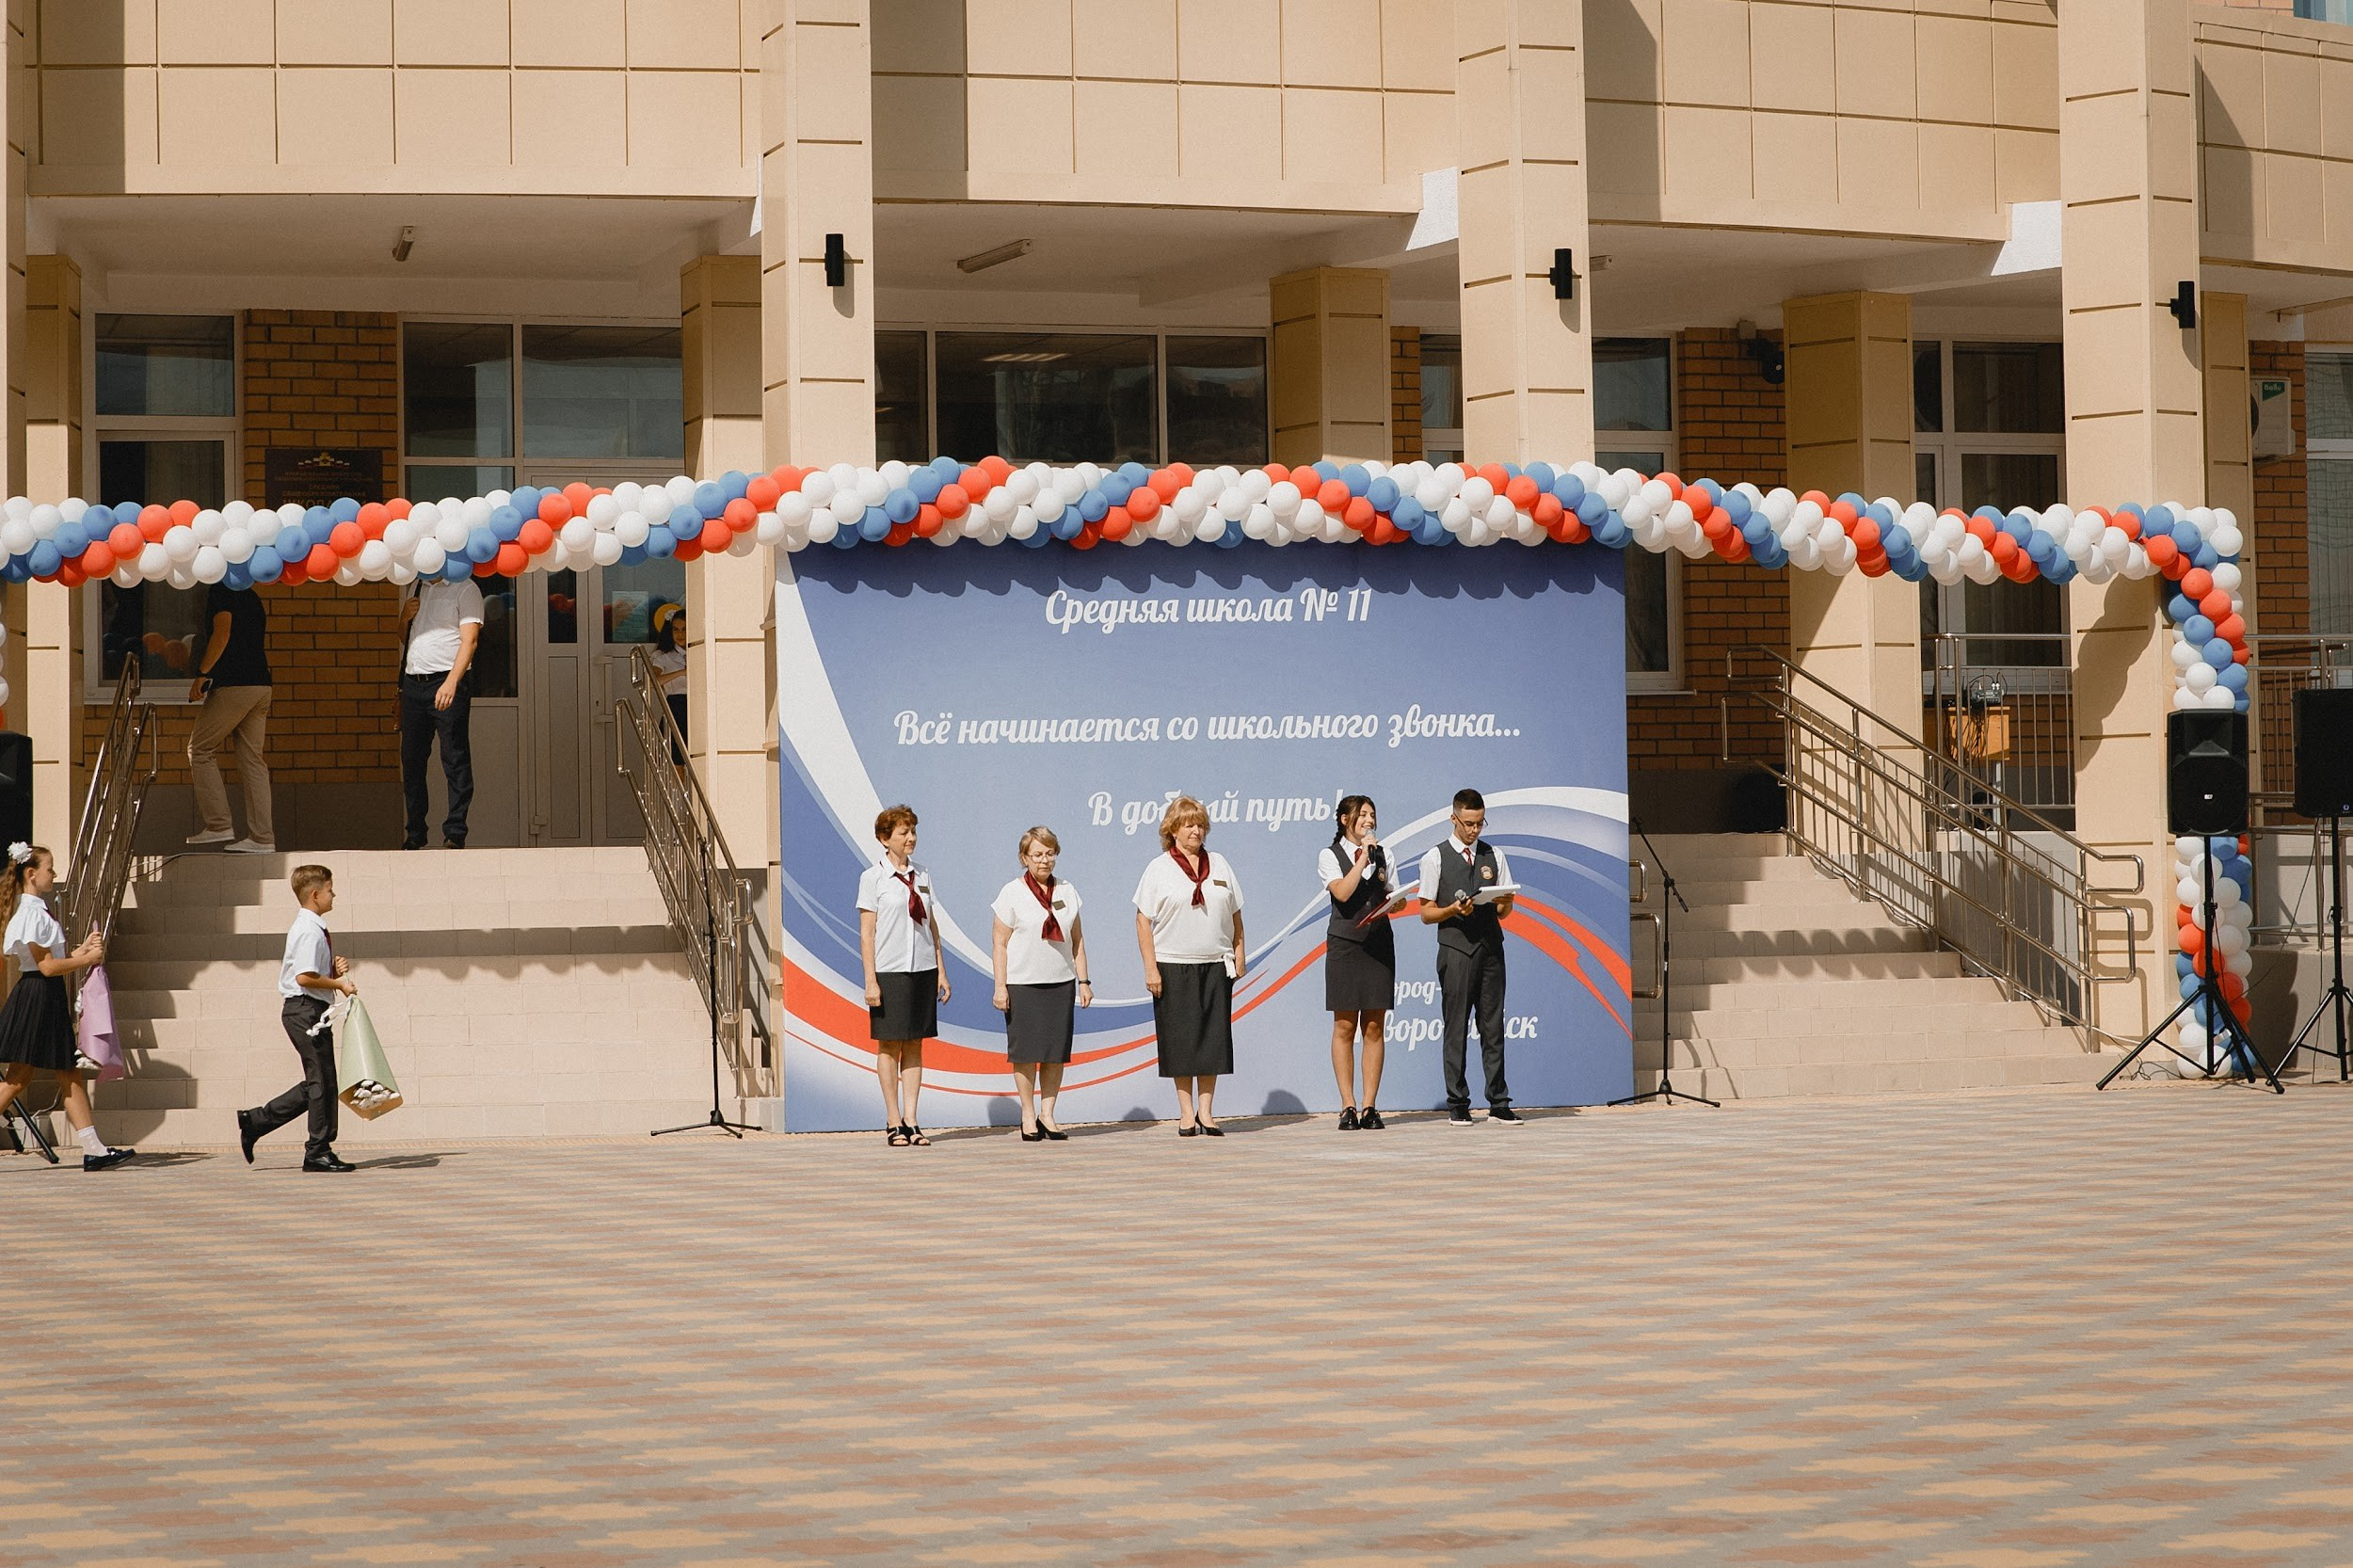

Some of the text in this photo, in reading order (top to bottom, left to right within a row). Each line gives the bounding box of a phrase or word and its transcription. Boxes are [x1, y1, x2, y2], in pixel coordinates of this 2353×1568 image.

[1045, 587, 1372, 634] Средняя школа № 11
[893, 703, 1521, 748] Всё начинается со школьного звонка...
[1088, 791, 1113, 826] В
